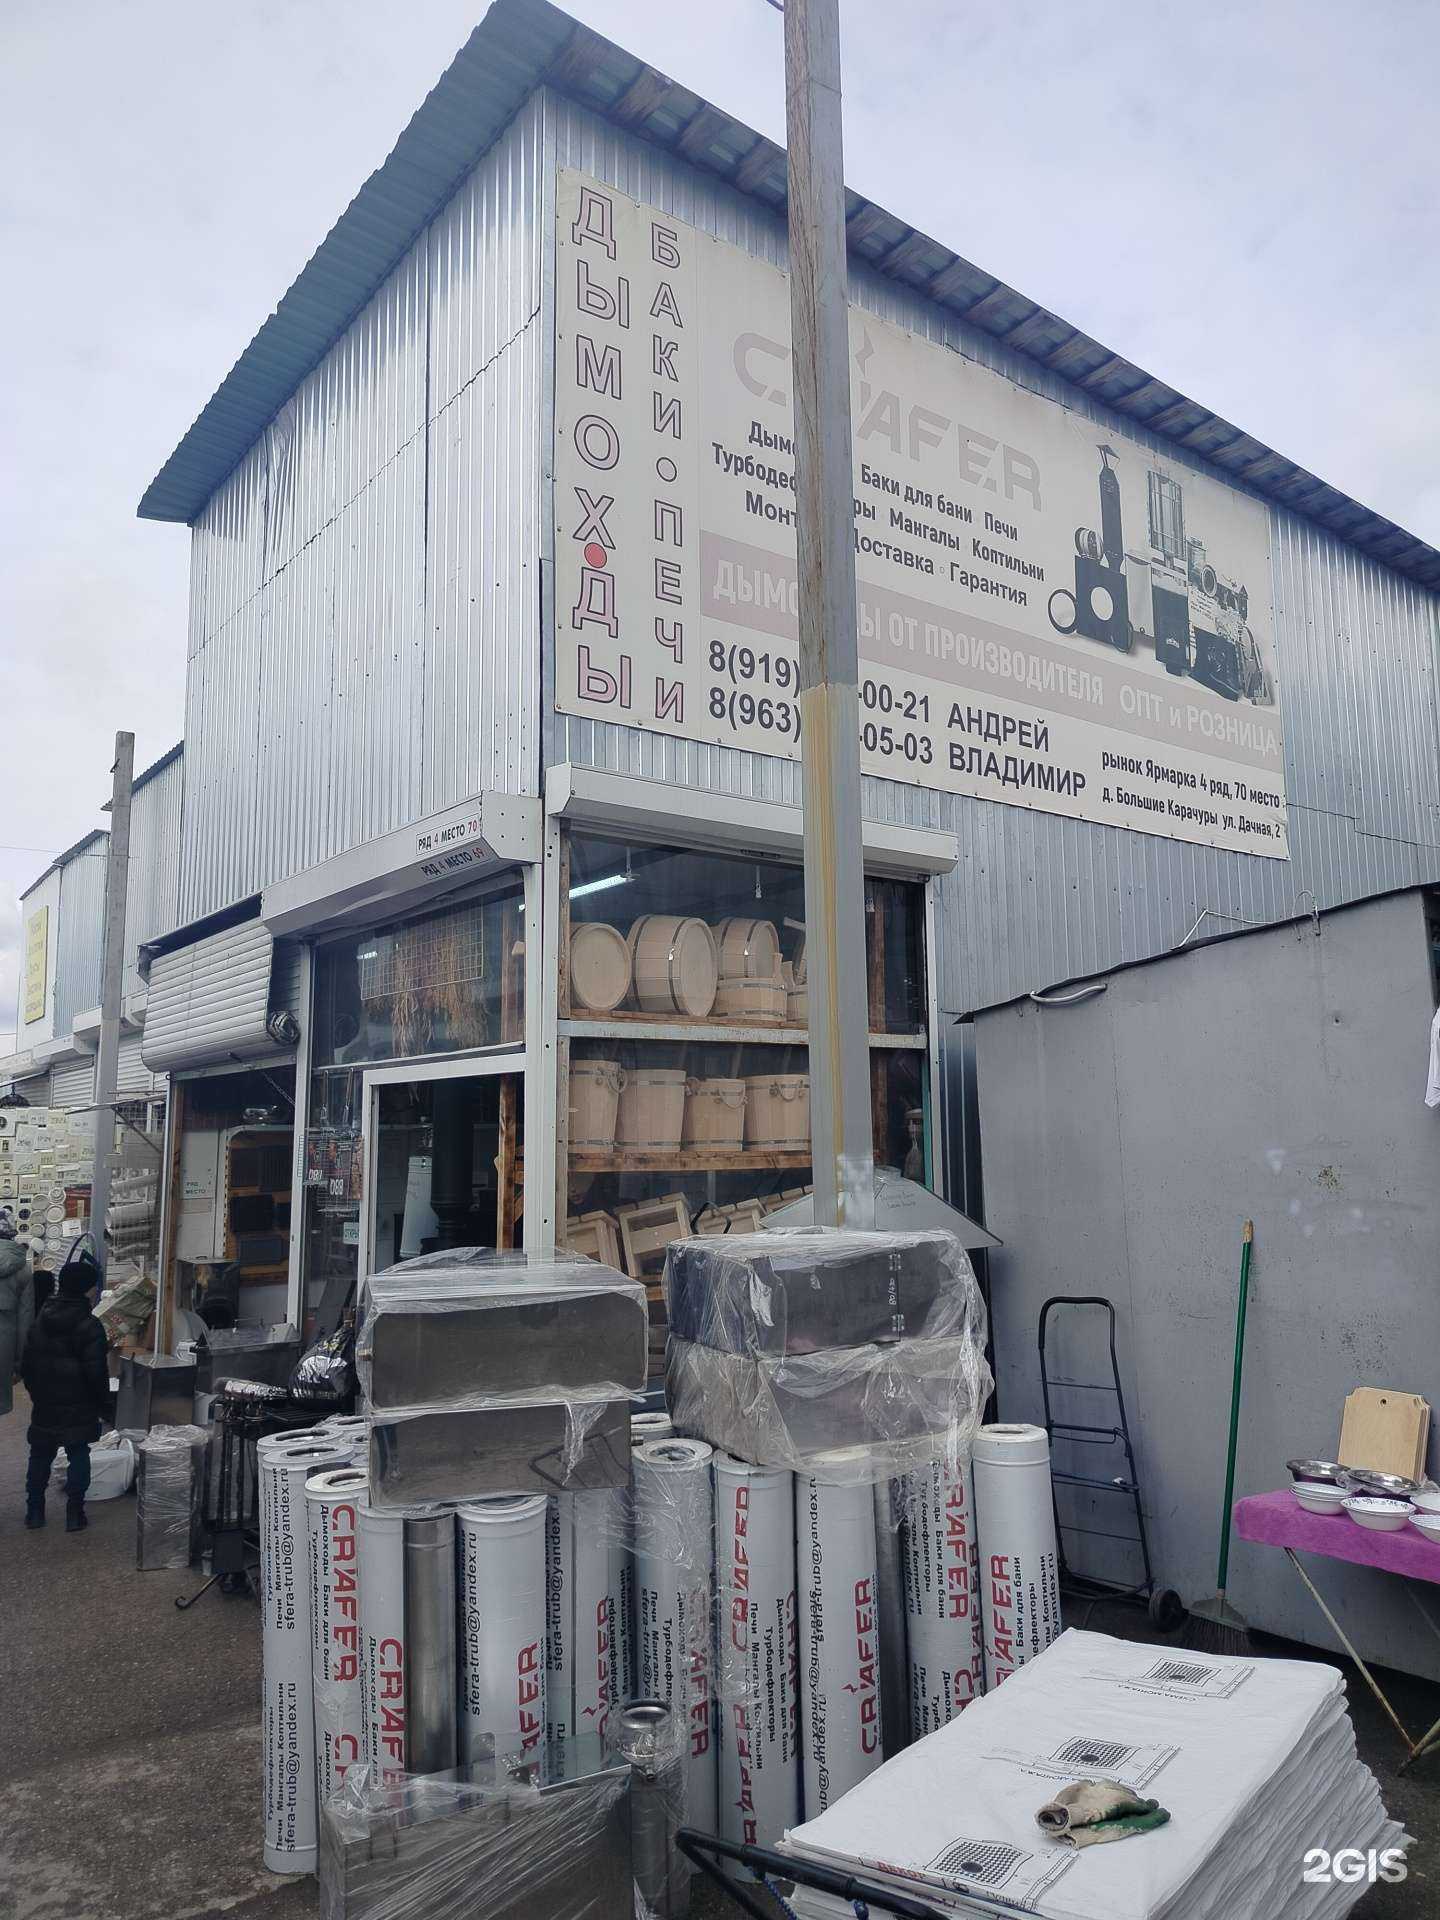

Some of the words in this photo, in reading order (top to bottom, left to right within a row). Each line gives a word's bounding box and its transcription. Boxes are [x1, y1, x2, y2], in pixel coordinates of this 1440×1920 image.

[733, 333, 1042, 513] CAFER
[861, 463, 900, 497] Баки
[904, 484, 933, 509] для
[937, 494, 973, 524] бани
[984, 511, 1019, 542] Печи
[889, 507, 960, 551] Мангалы
[972, 538, 1045, 582] Коптильни
[950, 561, 1028, 607] Гарантия
[888, 612, 919, 652] ОТ
[925, 622, 1104, 705] ПРОИЗВОДИТЕЛЯ
[1119, 684, 1165, 723] ОПТ
[1187, 704, 1279, 757] РОЗНИЦА
[948, 702, 1049, 752] АНДРЕЙ
[949, 742, 1086, 797] ВЛАДИМИР
[1101, 751, 1143, 776] рынок
[1146, 759, 1197, 789] Ярмарка
[1199, 773, 1208, 791] 4
[1209, 780, 1233, 800] ряд,
[1233, 781, 1247, 801] 70
[1249, 788, 1280, 809] место
[418, 835, 432, 851] РЯД
[434, 832, 439, 845] 4
[441, 823, 466, 843] МЕСТО
[467, 819, 478, 834] 70
[1102, 786, 1114, 803] д.
[1116, 786, 1165, 814] Большие
[1167, 799, 1218, 826] Карачуры
[1222, 813, 1237, 830] ул.
[1238, 815, 1274, 840] Дачная,
[1275, 824, 1281, 839] 2
[443, 851, 473, 869] МЕСТО
[274, 1536, 282, 1591] Мангалы
[280, 1467, 295, 1630] sfera-trub@yandex.ru
[320, 1505, 330, 1576] Дымоходы
[935, 1530, 943, 1559] Баки
[332, 1504, 358, 1682] CRAFER
[936, 1563, 944, 1586] для
[1013, 1556, 1023, 1588] бани
[1039, 1555, 1050, 1623] Коптильни
[275, 1598, 283, 1630] Печи
[466, 1532, 481, 1716] sfera-trub@yandex.ru
[750, 1602, 759, 1634] Печи
[1015, 1591, 1024, 1615] для
[322, 1619, 330, 1644] для
[775, 1598, 785, 1666] Дымоходы
[1014, 1617, 1024, 1648] Баки
[368, 1635, 377, 1714] Дымоходы
[751, 1641, 761, 1699] Мангалы
[764, 1626, 777, 1742] Турбодефлекторы
[779, 1671, 788, 1704] Баки
[855, 1577, 877, 1754] CRAFER
[276, 1682, 284, 1750] Коптильни
[371, 1722, 379, 1756] Баки
[780, 1707, 788, 1730] для
[276, 1753, 284, 1812] Мангалы
[284, 1682, 300, 1853] sfera-trub@yandex.ru
[276, 1818, 284, 1852] Печи
